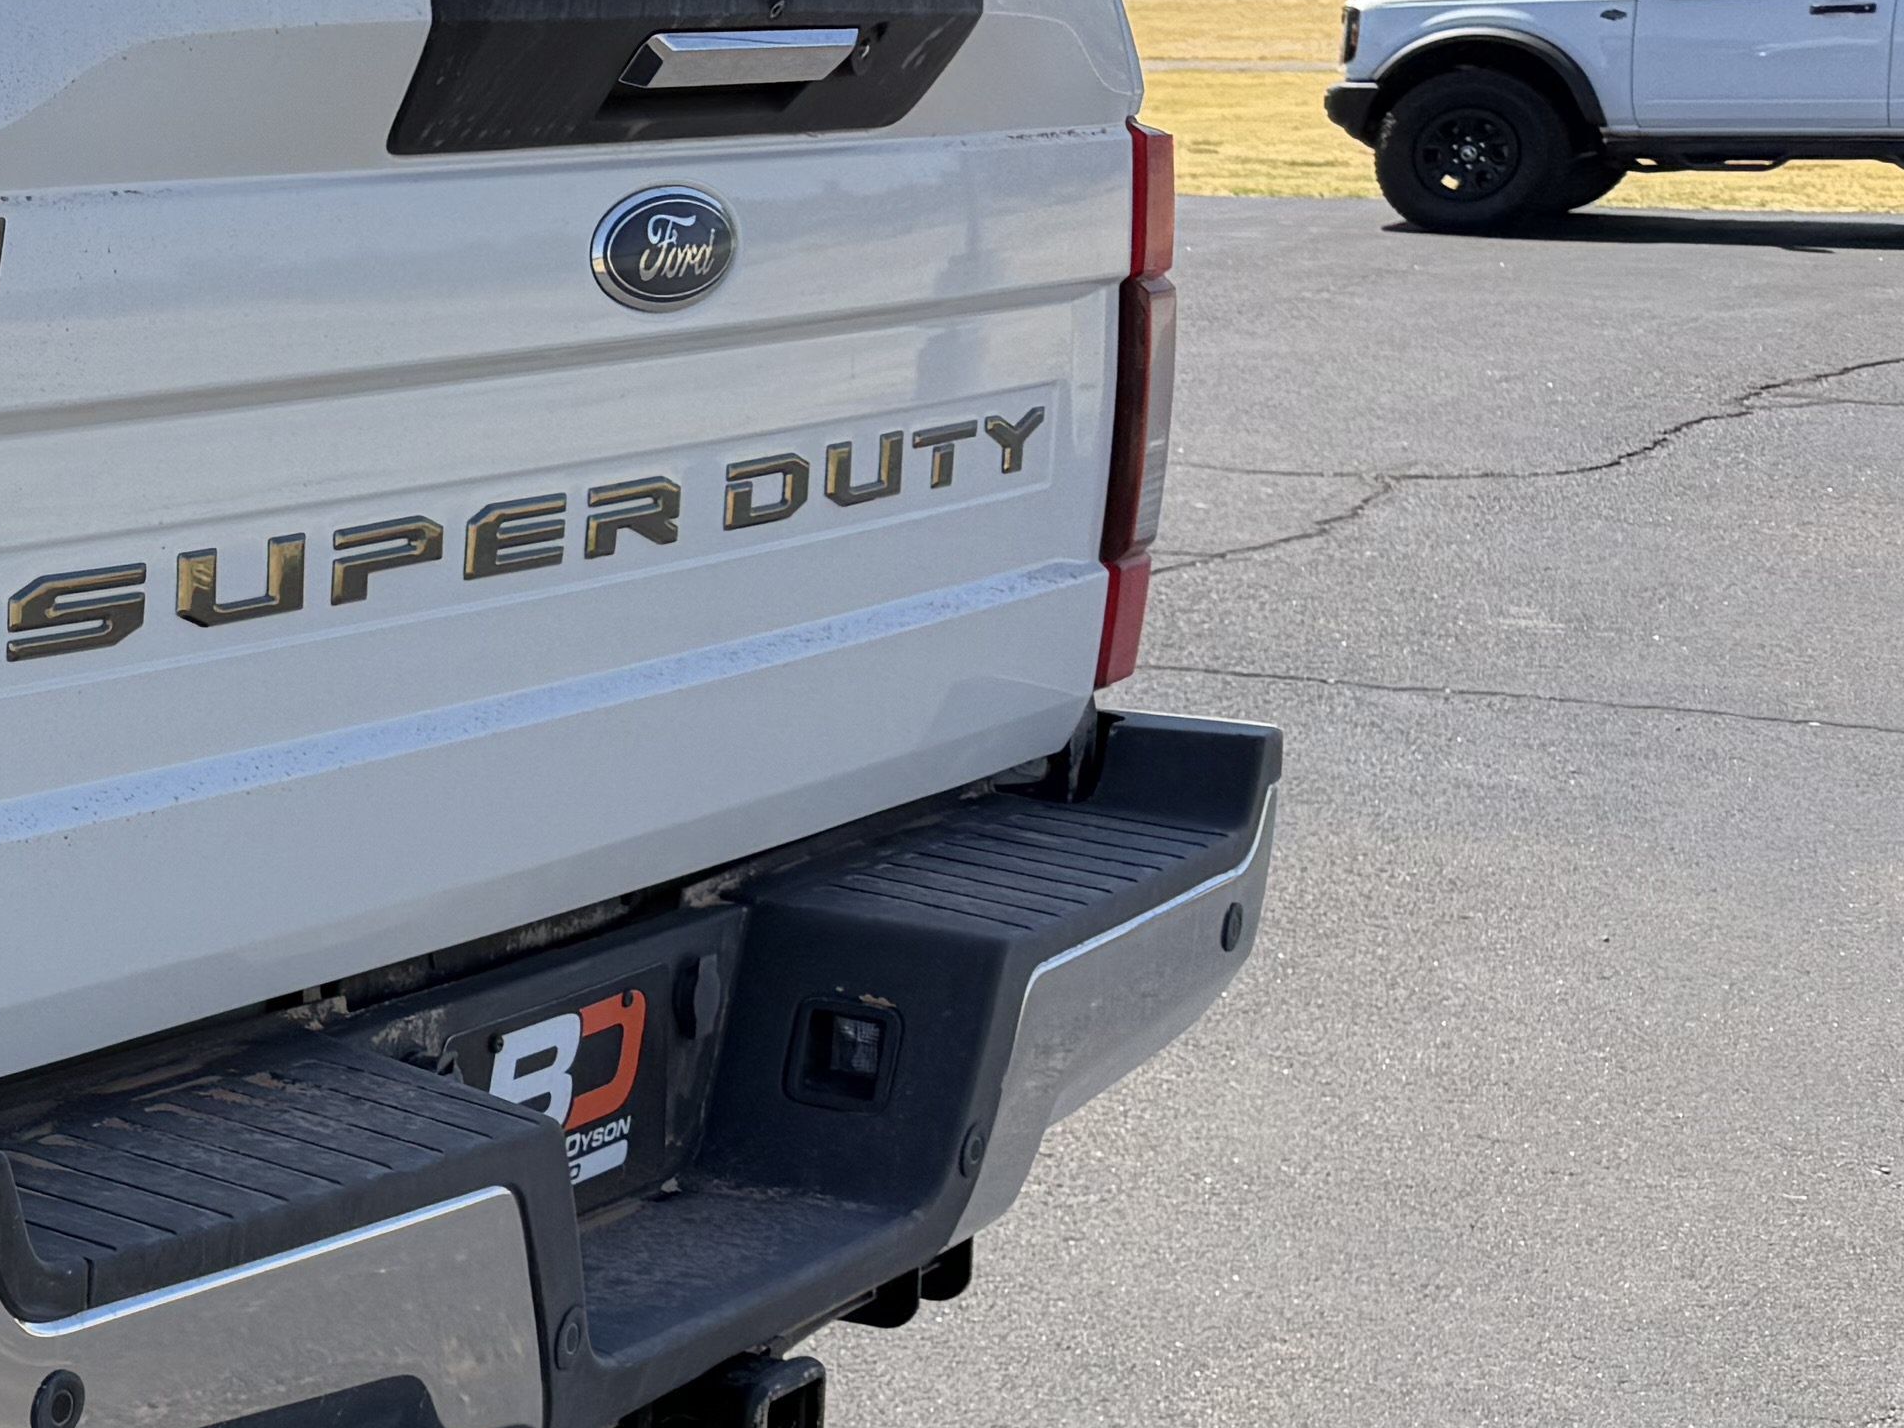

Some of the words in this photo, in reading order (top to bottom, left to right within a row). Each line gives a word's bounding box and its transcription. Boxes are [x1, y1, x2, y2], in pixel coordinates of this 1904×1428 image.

[639, 214, 716, 282] Ford
[7, 474, 681, 662] SUPER
[722, 406, 1046, 531] DUTY
